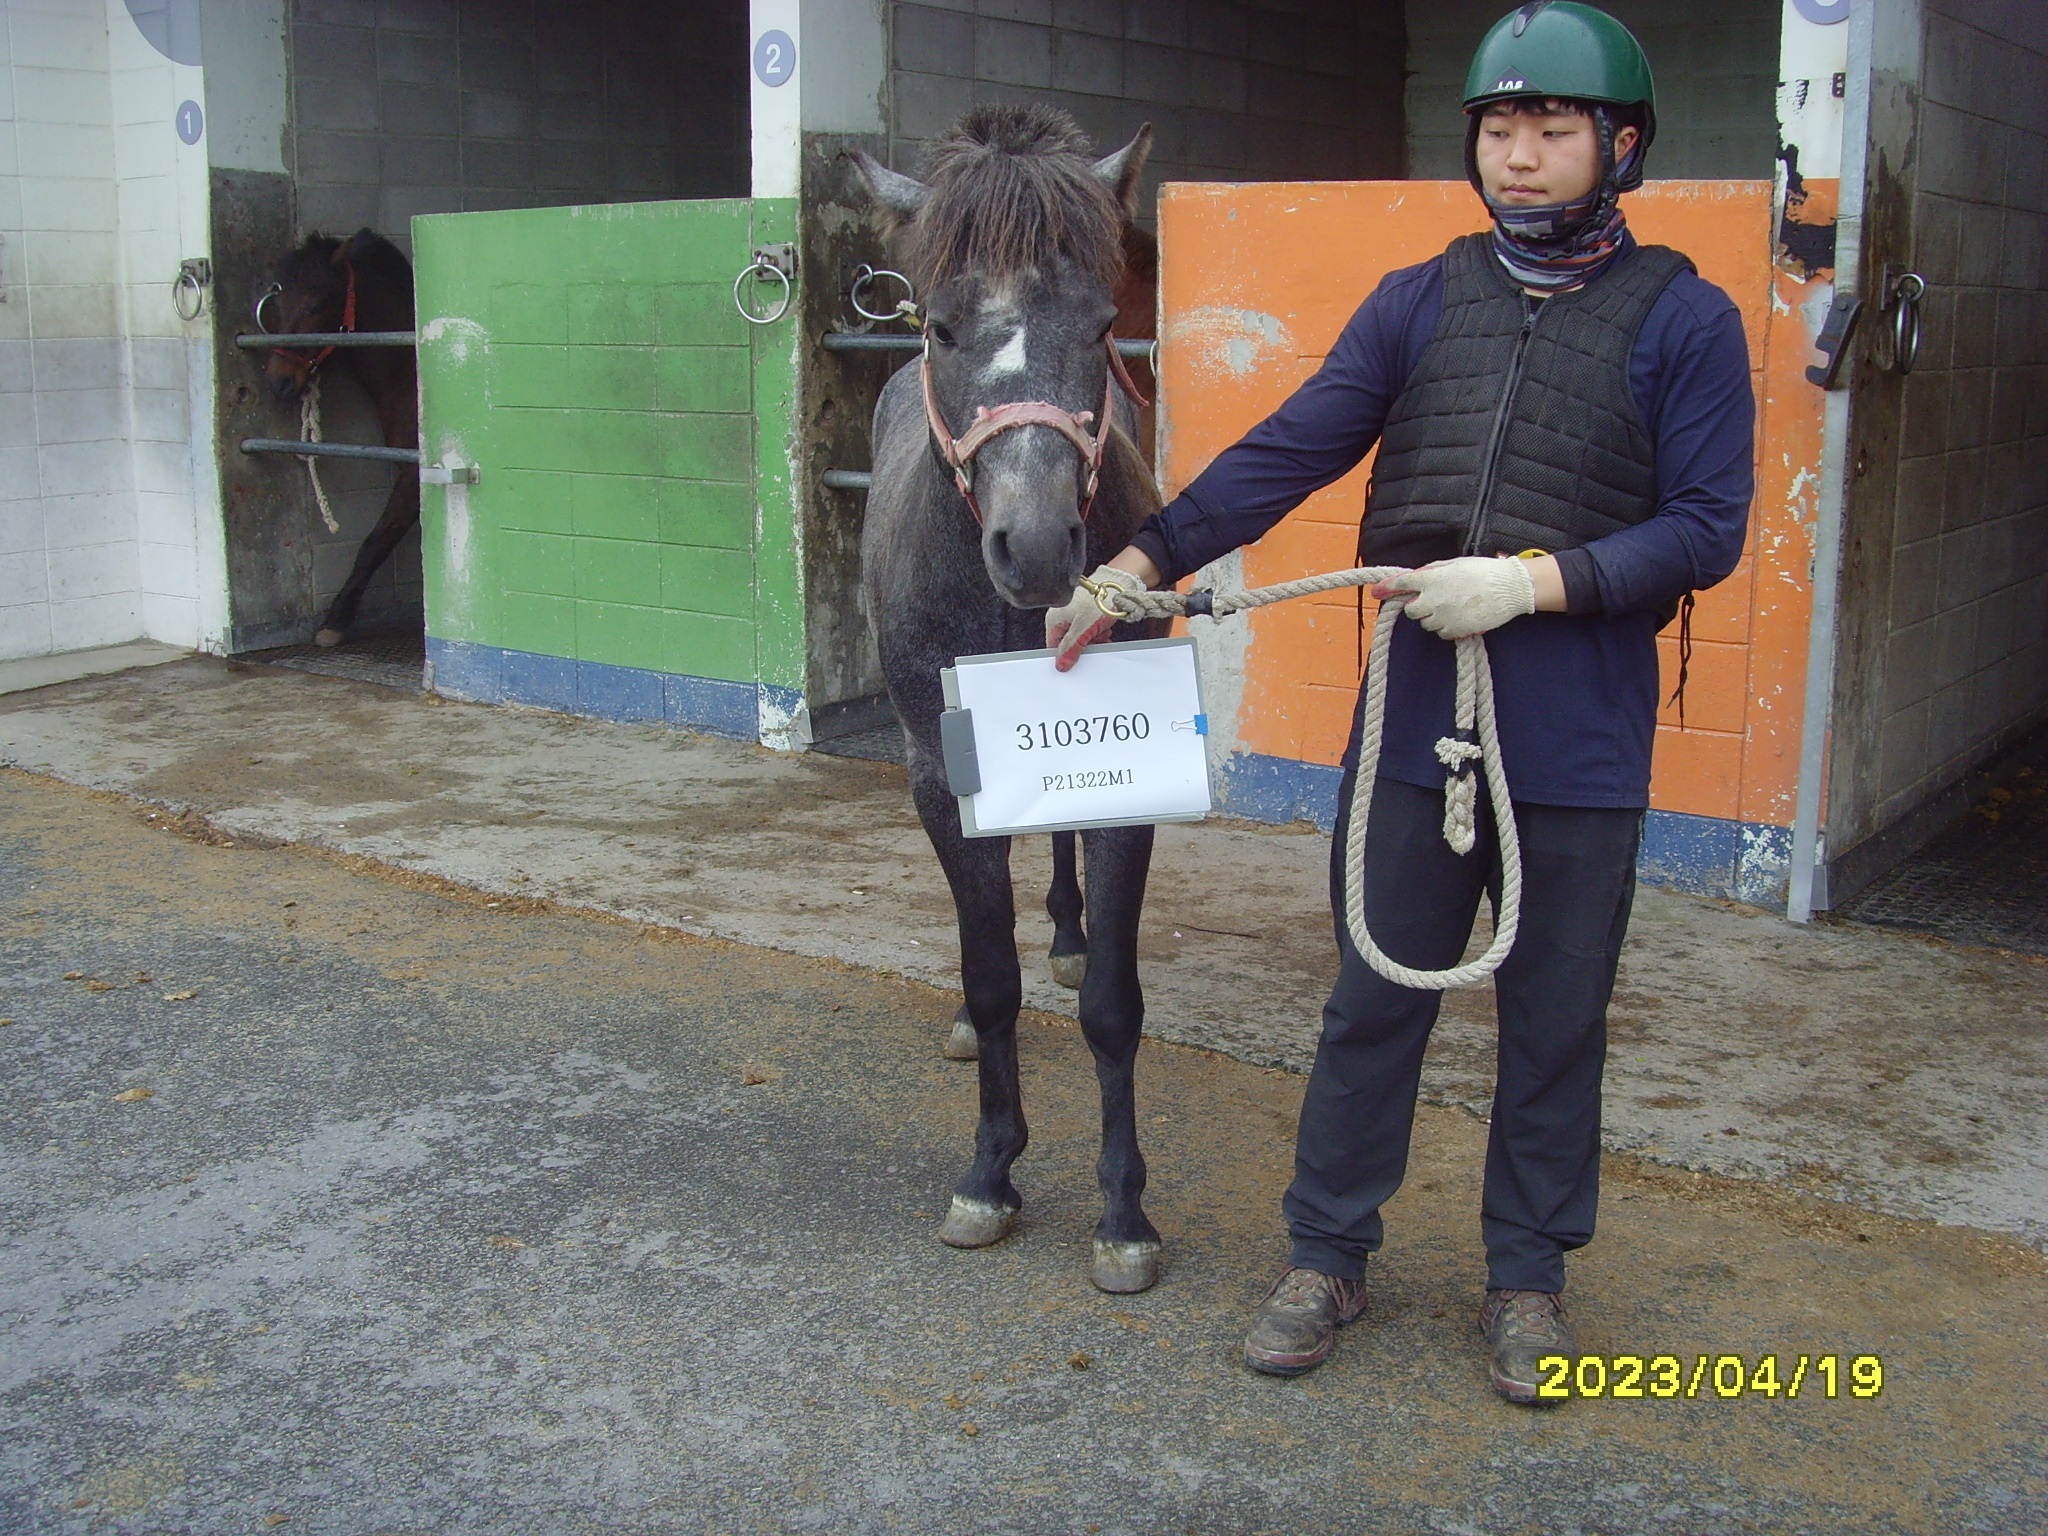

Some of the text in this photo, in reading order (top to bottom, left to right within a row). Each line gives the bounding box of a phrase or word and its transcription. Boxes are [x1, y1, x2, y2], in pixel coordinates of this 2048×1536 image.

[765, 43, 781, 74] 2
[184, 110, 192, 135] 1
[1016, 712, 1150, 751] 3103760
[1042, 768, 1135, 792] P21322M1
